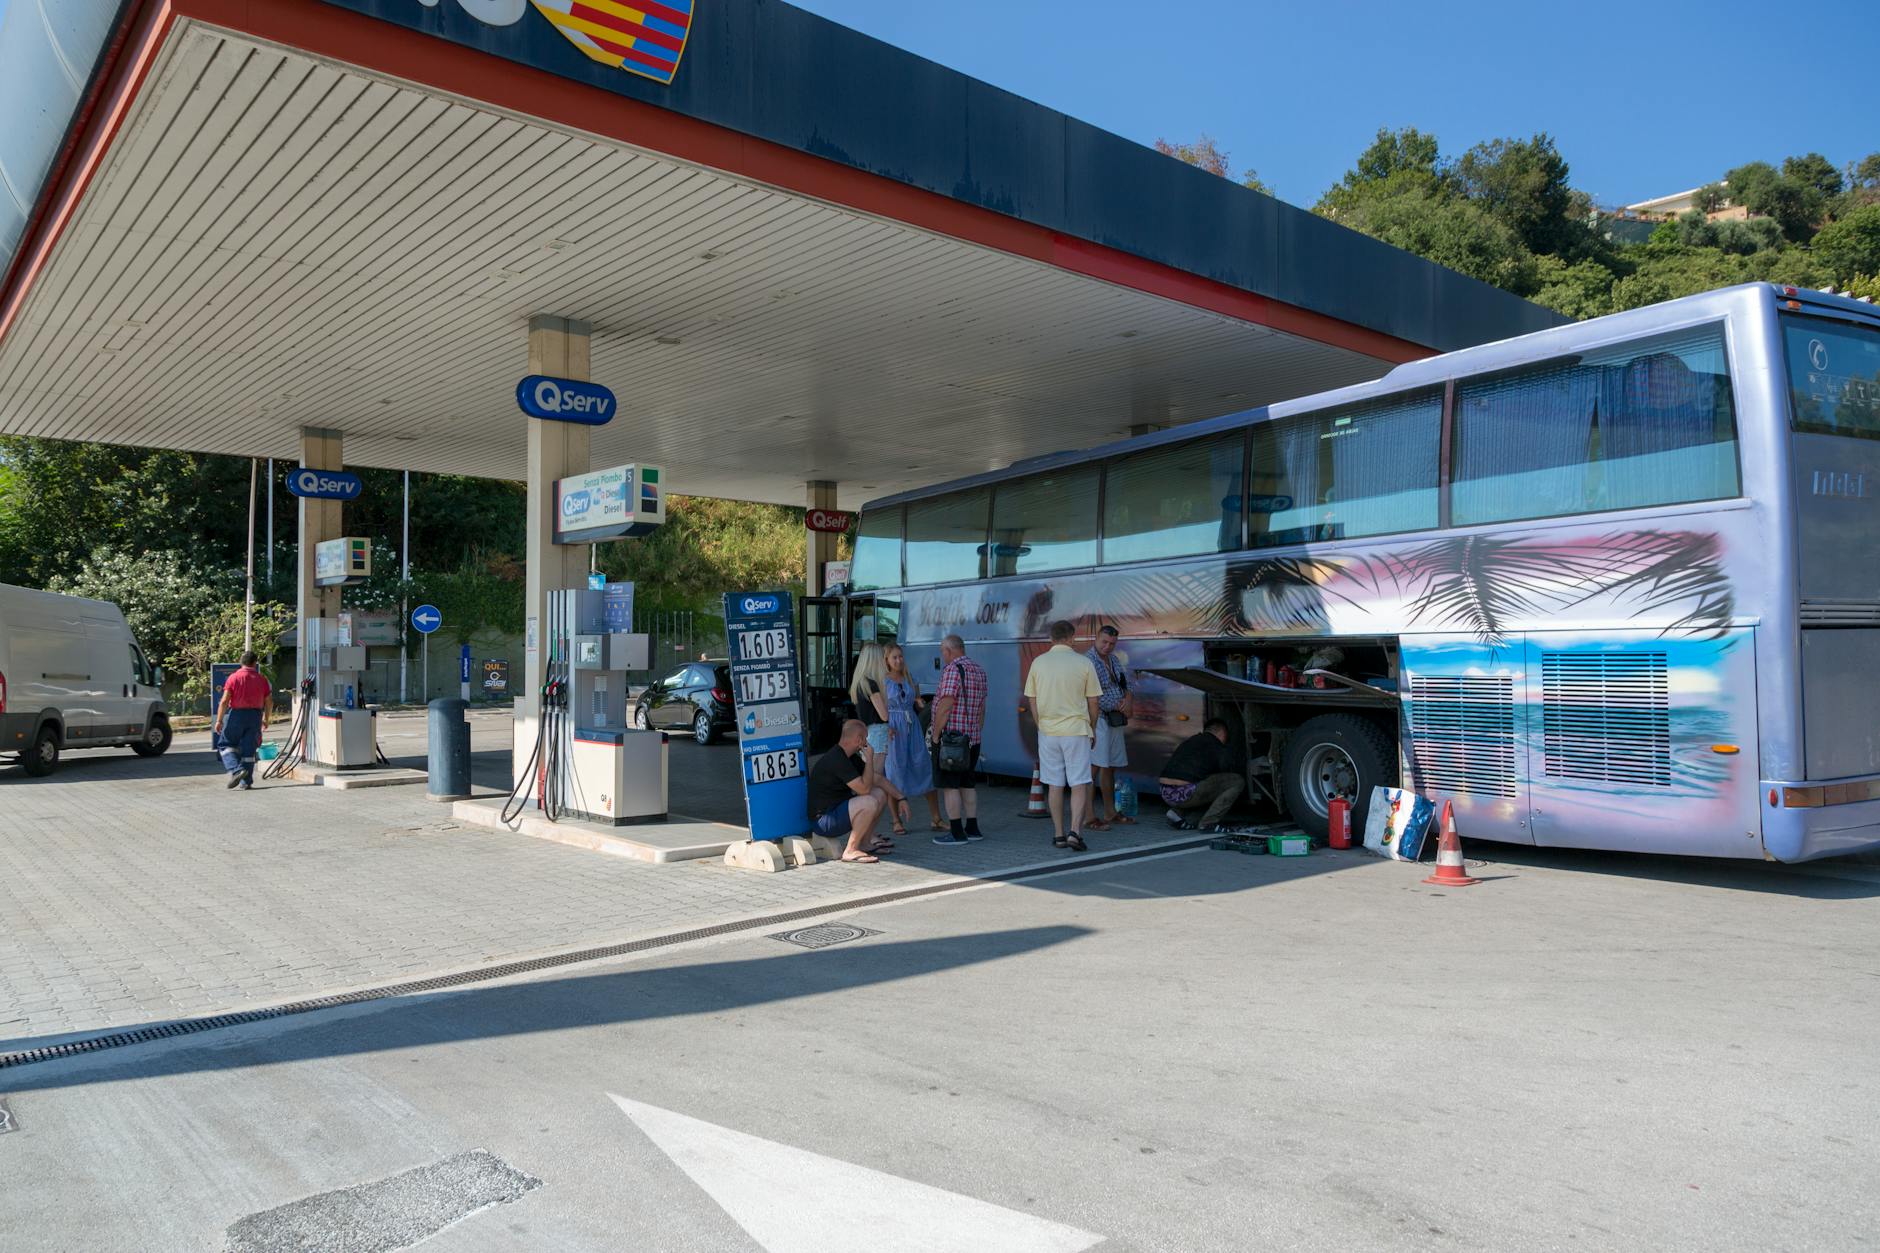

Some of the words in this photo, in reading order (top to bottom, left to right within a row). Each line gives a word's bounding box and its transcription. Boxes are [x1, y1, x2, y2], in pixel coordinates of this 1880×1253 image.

[535, 381, 609, 414] QServ
[298, 472, 355, 493] QServ
[813, 511, 847, 528] QSelf
[753, 752, 797, 782] 1,863
